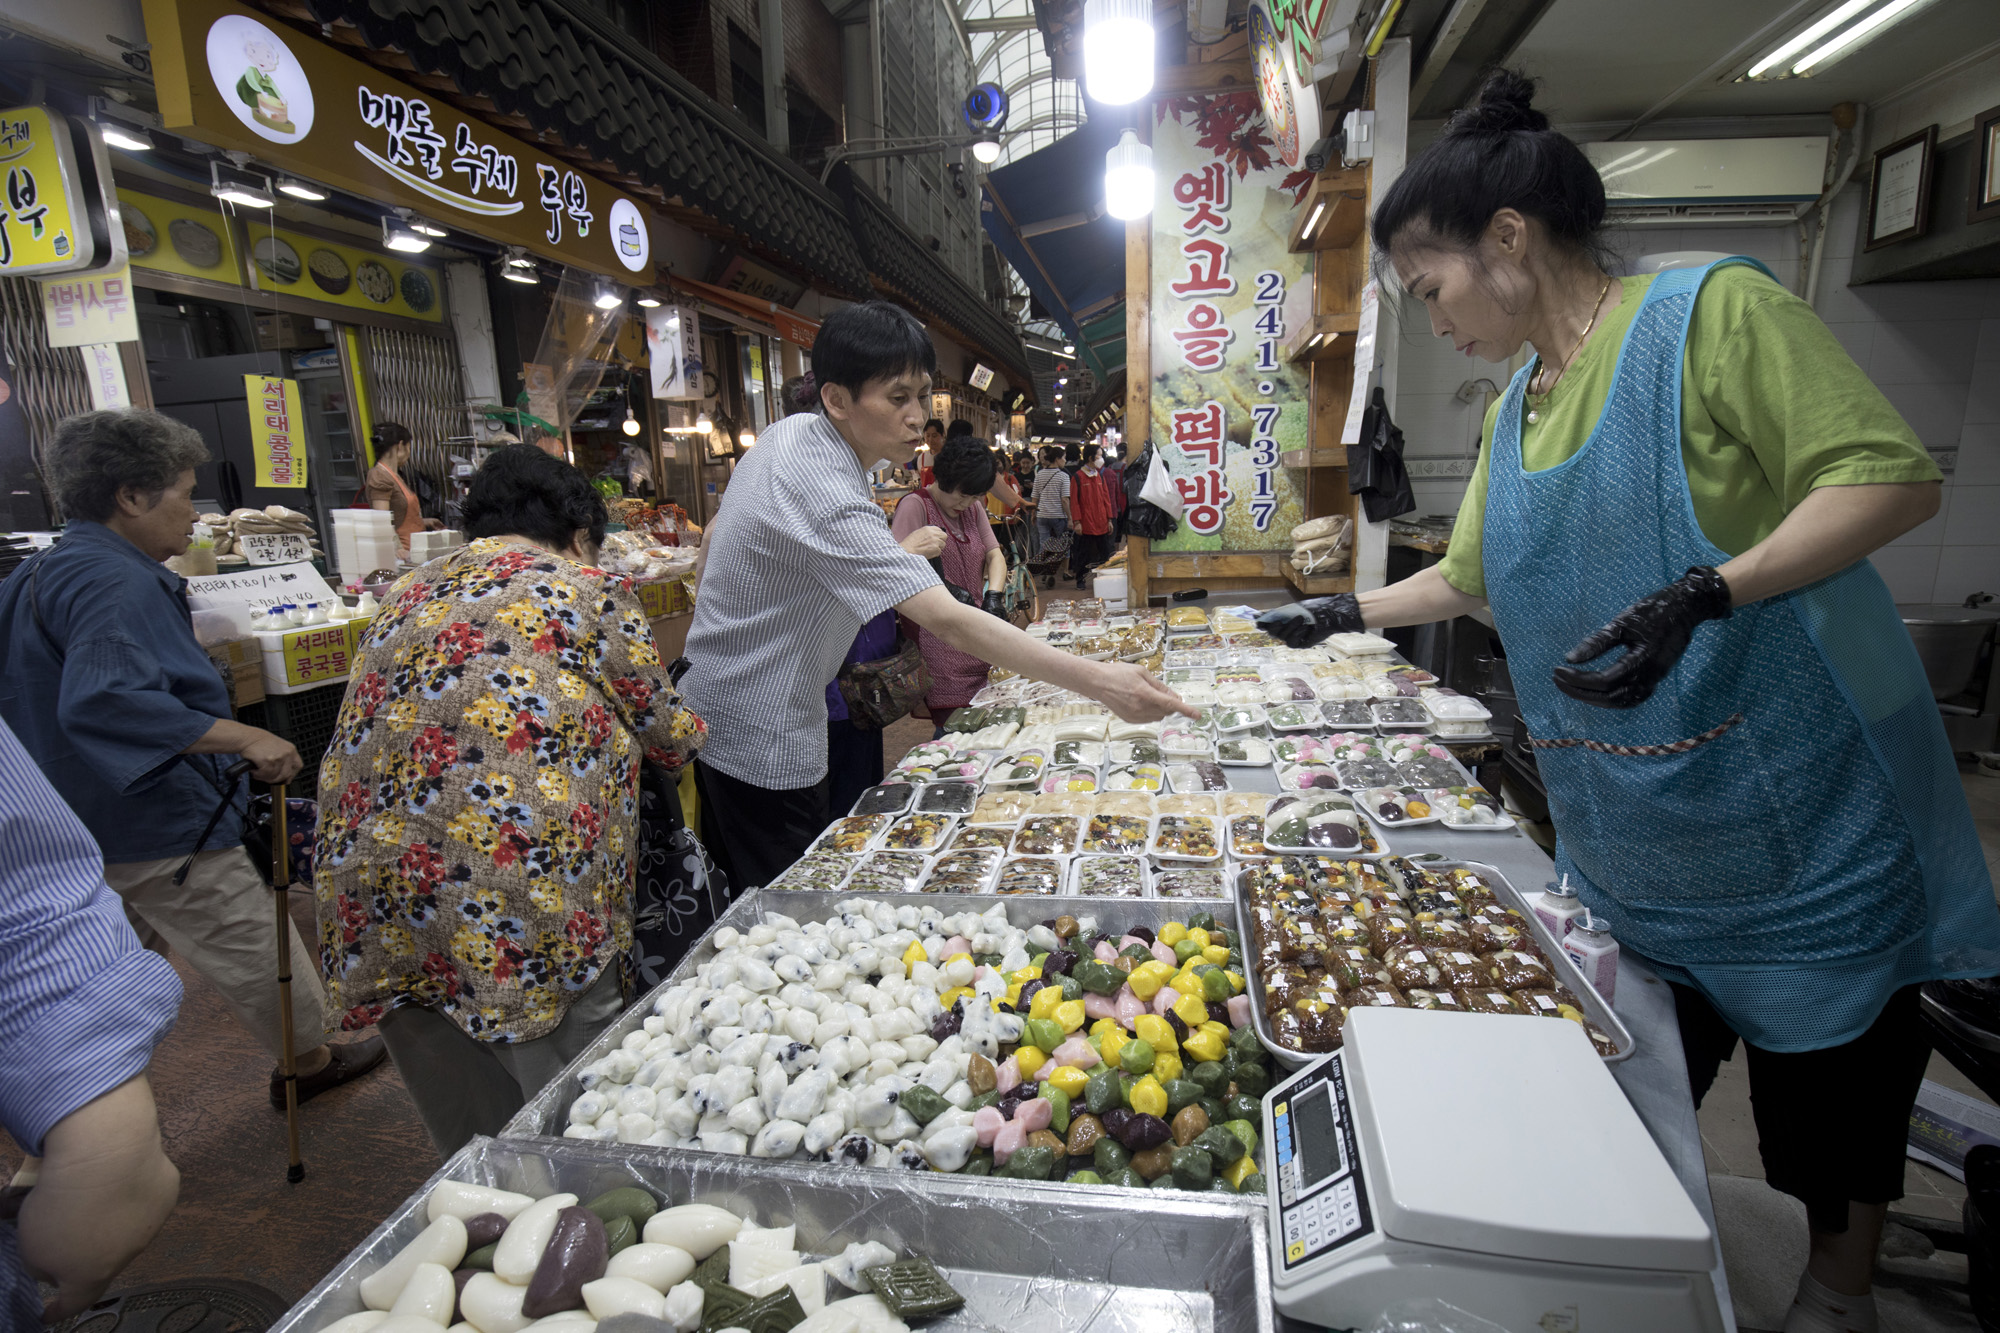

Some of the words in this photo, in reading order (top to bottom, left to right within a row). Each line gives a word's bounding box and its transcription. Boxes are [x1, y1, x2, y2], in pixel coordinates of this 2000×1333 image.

[1, 119, 31, 151] 수제
[358, 87, 446, 178] 맷돌
[451, 124, 517, 196] 수제
[537, 164, 593, 243] 두부
[1171, 161, 1233, 368] 옛고을
[263, 382, 289, 433] 서리태
[267, 433, 295, 484] 콩국물
[1172, 403, 1229, 530] 떡방
[249, 536, 277, 548] 고소한
[191, 578, 231, 595] 서리태
[294, 628, 345, 652] 서리태
[296, 651, 348, 679] 콩국물
[1331, 1059, 1341, 1078] ACOM
[1335, 1078, 1346, 1101] PC-500
[1340, 1184, 1350, 1193] 7
[1343, 1201, 1352, 1210] 8
[1325, 1211, 1334, 1219] 5
[1345, 1218, 1355, 1227] 9
[1290, 1227, 1300, 1240] 00
[1307, 1221, 1317, 1229] 2
[1327, 1228, 1337, 1236] 6
[1309, 1238, 1319, 1246] 3
[1291, 1246, 1301, 1256] C
